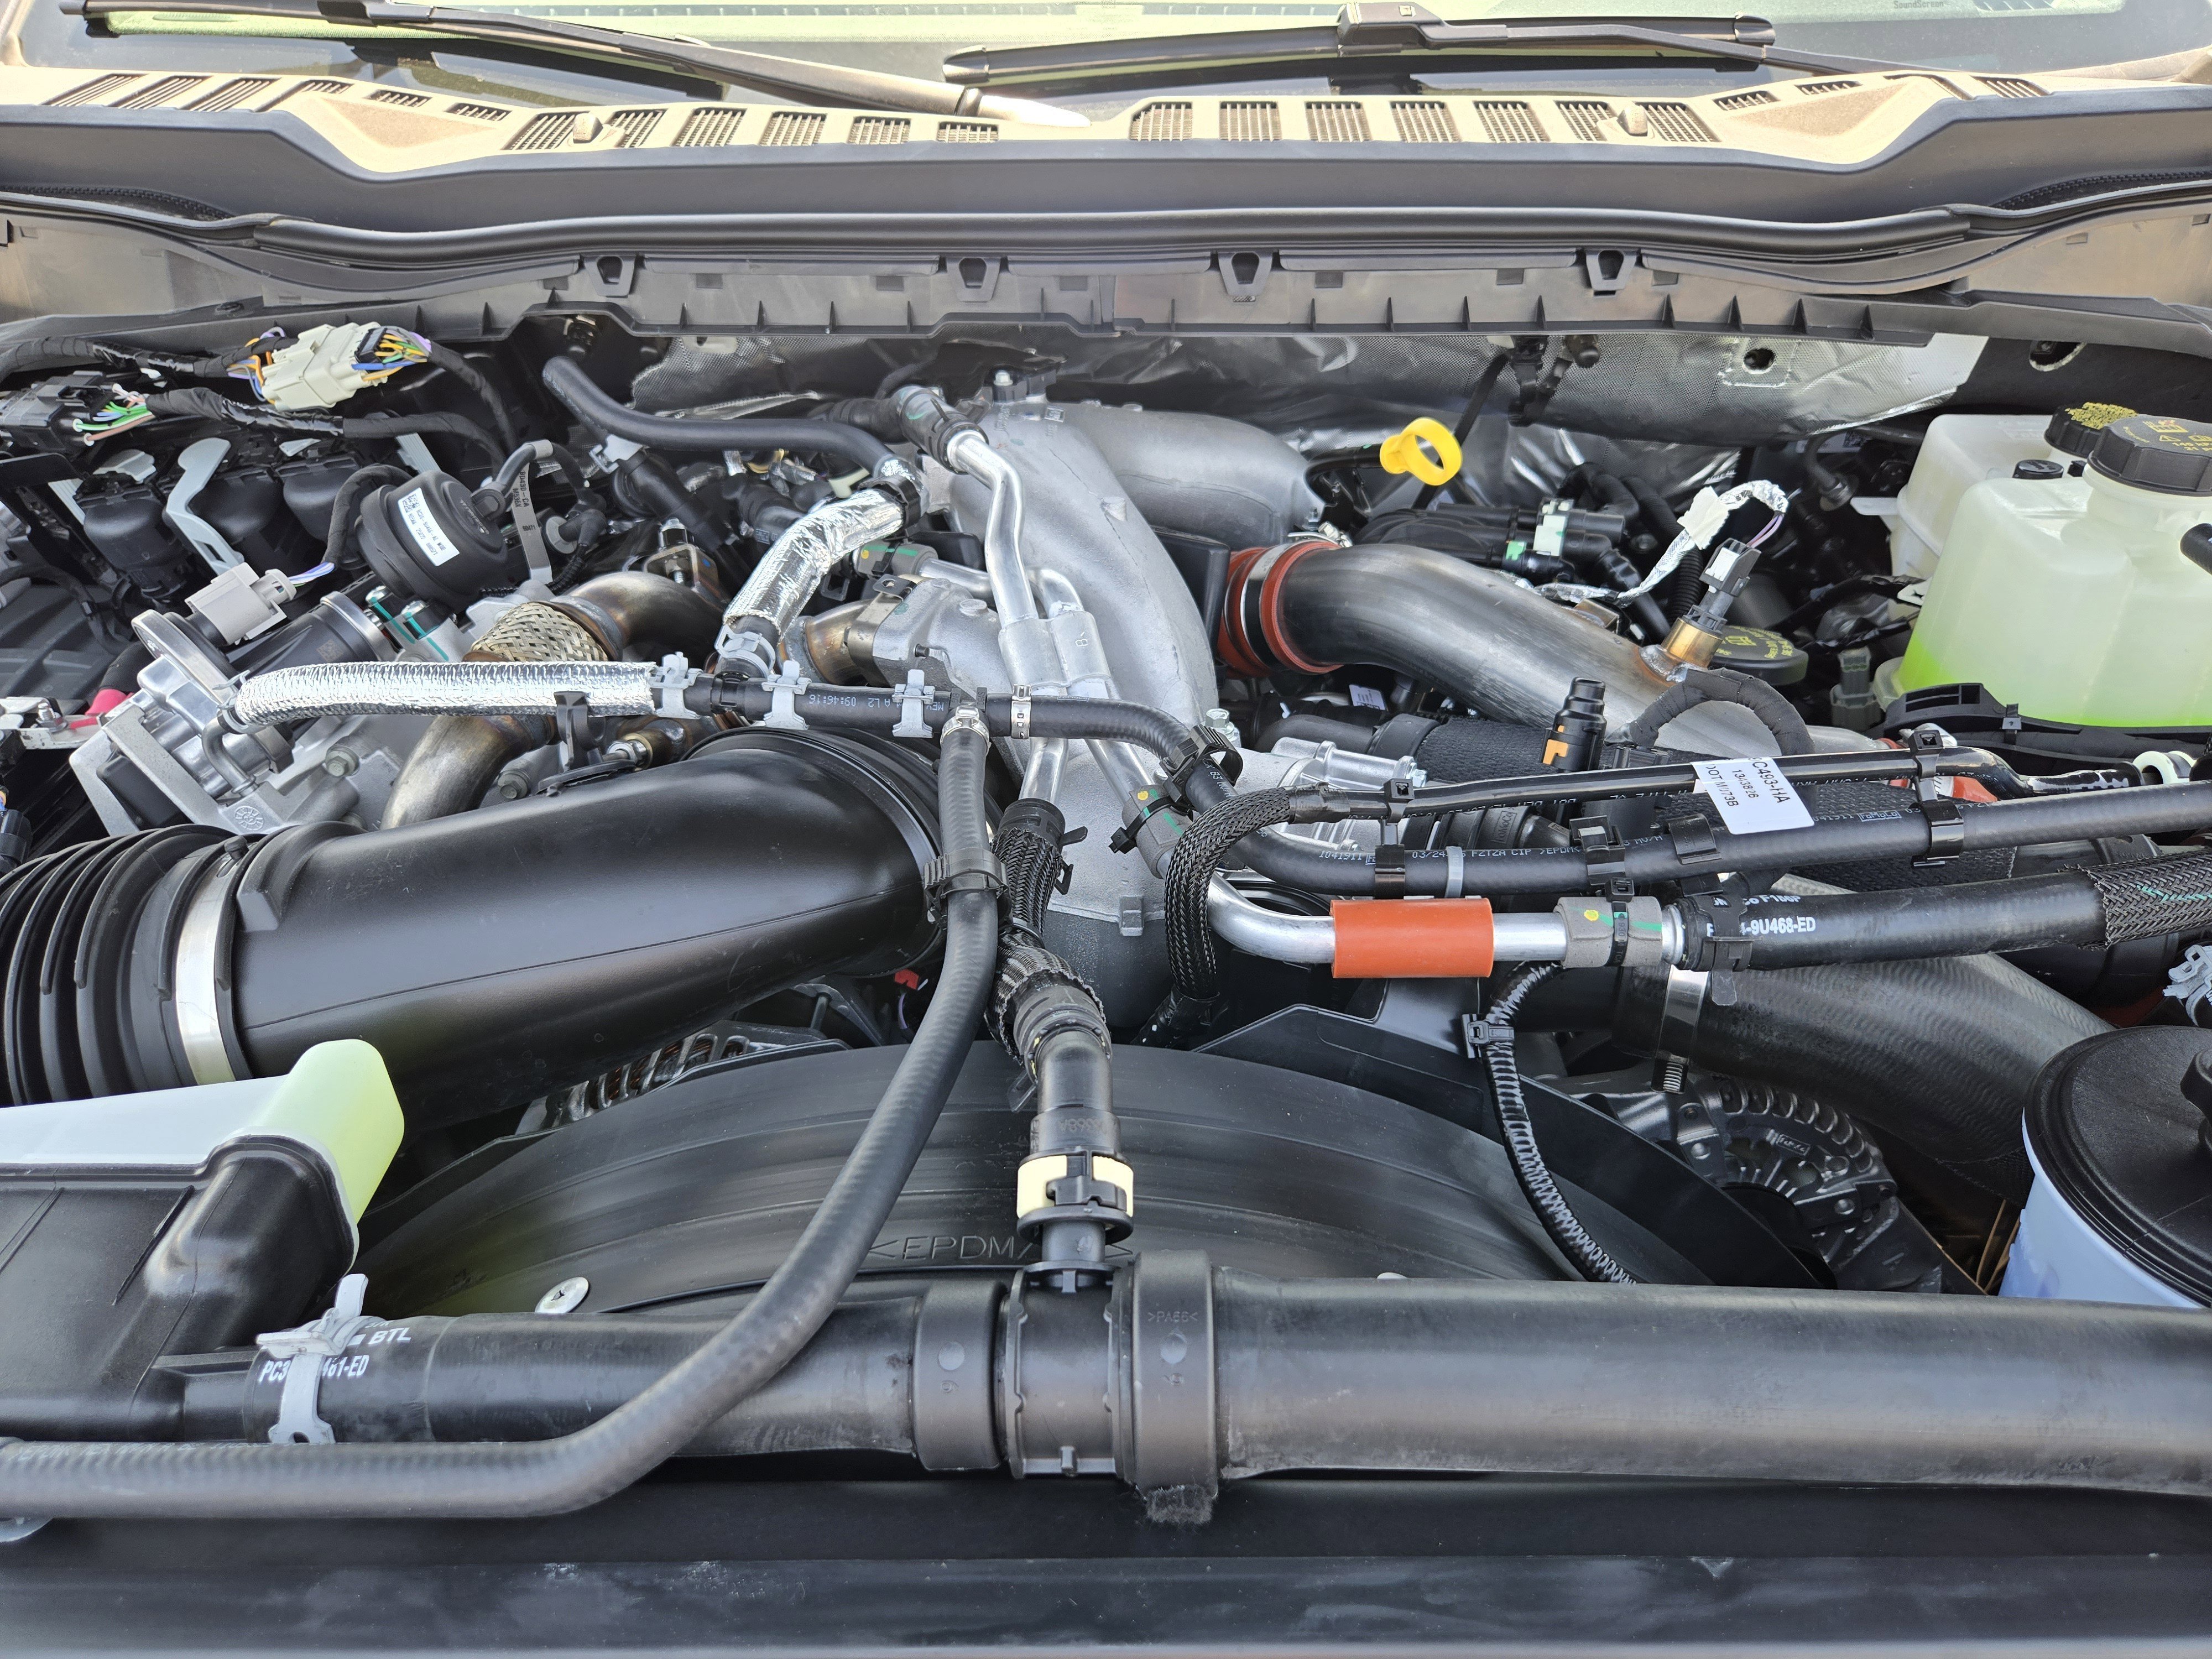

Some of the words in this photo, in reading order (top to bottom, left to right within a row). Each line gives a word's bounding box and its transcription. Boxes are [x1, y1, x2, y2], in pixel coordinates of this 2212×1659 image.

[1893, 0, 1943, 9] SoundScreen
[808, 694, 857, 707] 09:46:16
[368, 1327, 411, 1344] BTL
